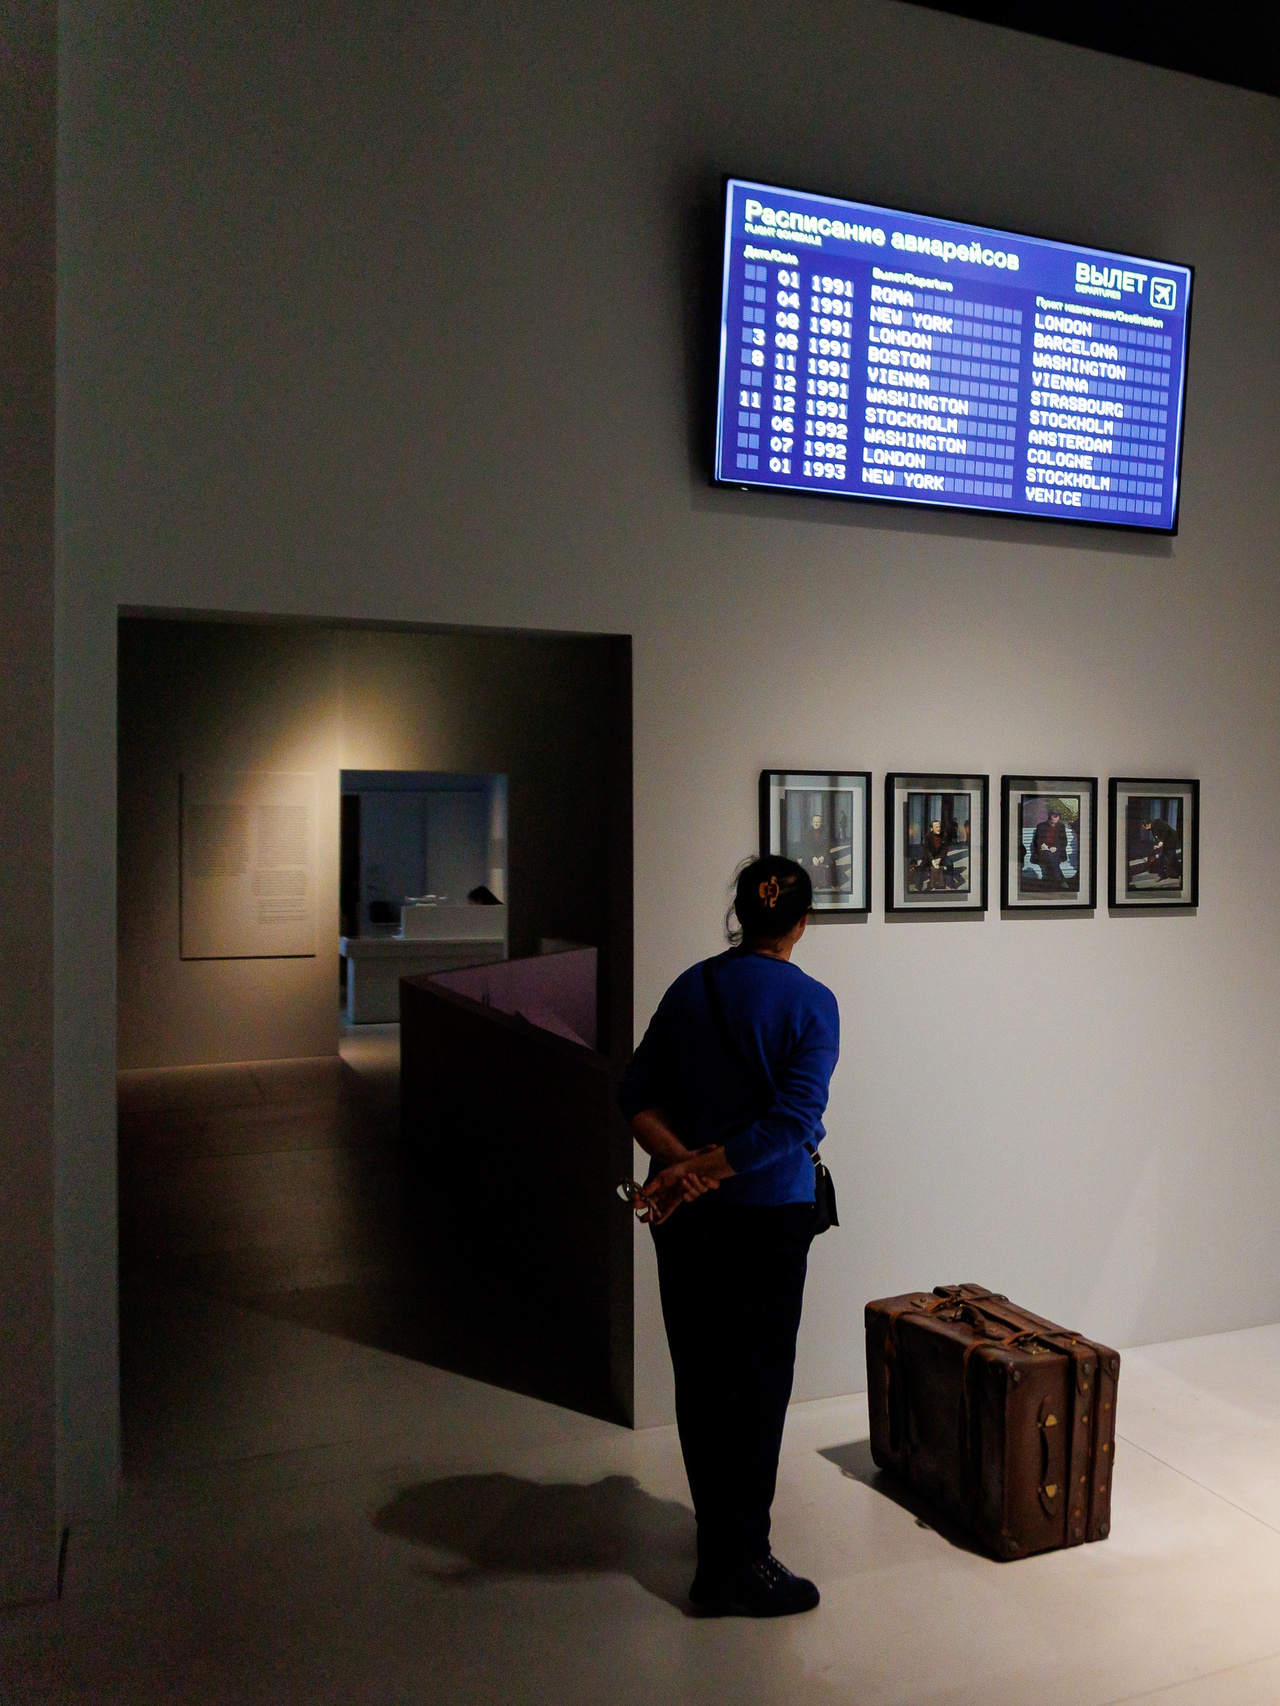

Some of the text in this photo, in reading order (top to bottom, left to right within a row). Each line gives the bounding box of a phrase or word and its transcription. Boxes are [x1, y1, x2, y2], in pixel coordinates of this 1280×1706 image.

[743, 244, 799, 266] Дата/Date
[745, 223, 822, 246] FLIGHT SCHEDULE
[745, 199, 1020, 271] Расписание авиарейсов
[778, 269, 1092, 337] 01 1991 ROMA LONDON
[872, 267, 954, 292] Вылет/Departure
[1036, 296, 1064, 311] Пункт
[1075, 283, 1122, 300] DEPARTURES
[1076, 262, 1148, 294] ВЫЛЕТ
[775, 311, 1126, 381] 08 1991 LONDON WASHINGTON
[777, 290, 1118, 361] 04 1991 NEW YORK BARCELONA
[751, 349, 1124, 418] 8 11 1991 VIENNA STRASBOURG
[752, 328, 1089, 394] 3 08 1991 BOSTON VIENNA
[739, 390, 1113, 454] 11 12 1991 STOCKHOLM AMSTERDAM
[774, 373, 1114, 435] 12 1991 WASHINGTON STOCKHOLM
[770, 436, 1111, 491] 07 1992 LONDON STOCKHOLM
[771, 415, 1093, 471] 06 1992 WASHINGTON COLOGNE
[769, 456, 1082, 507] 01 1993 NEW YORK VENICE
